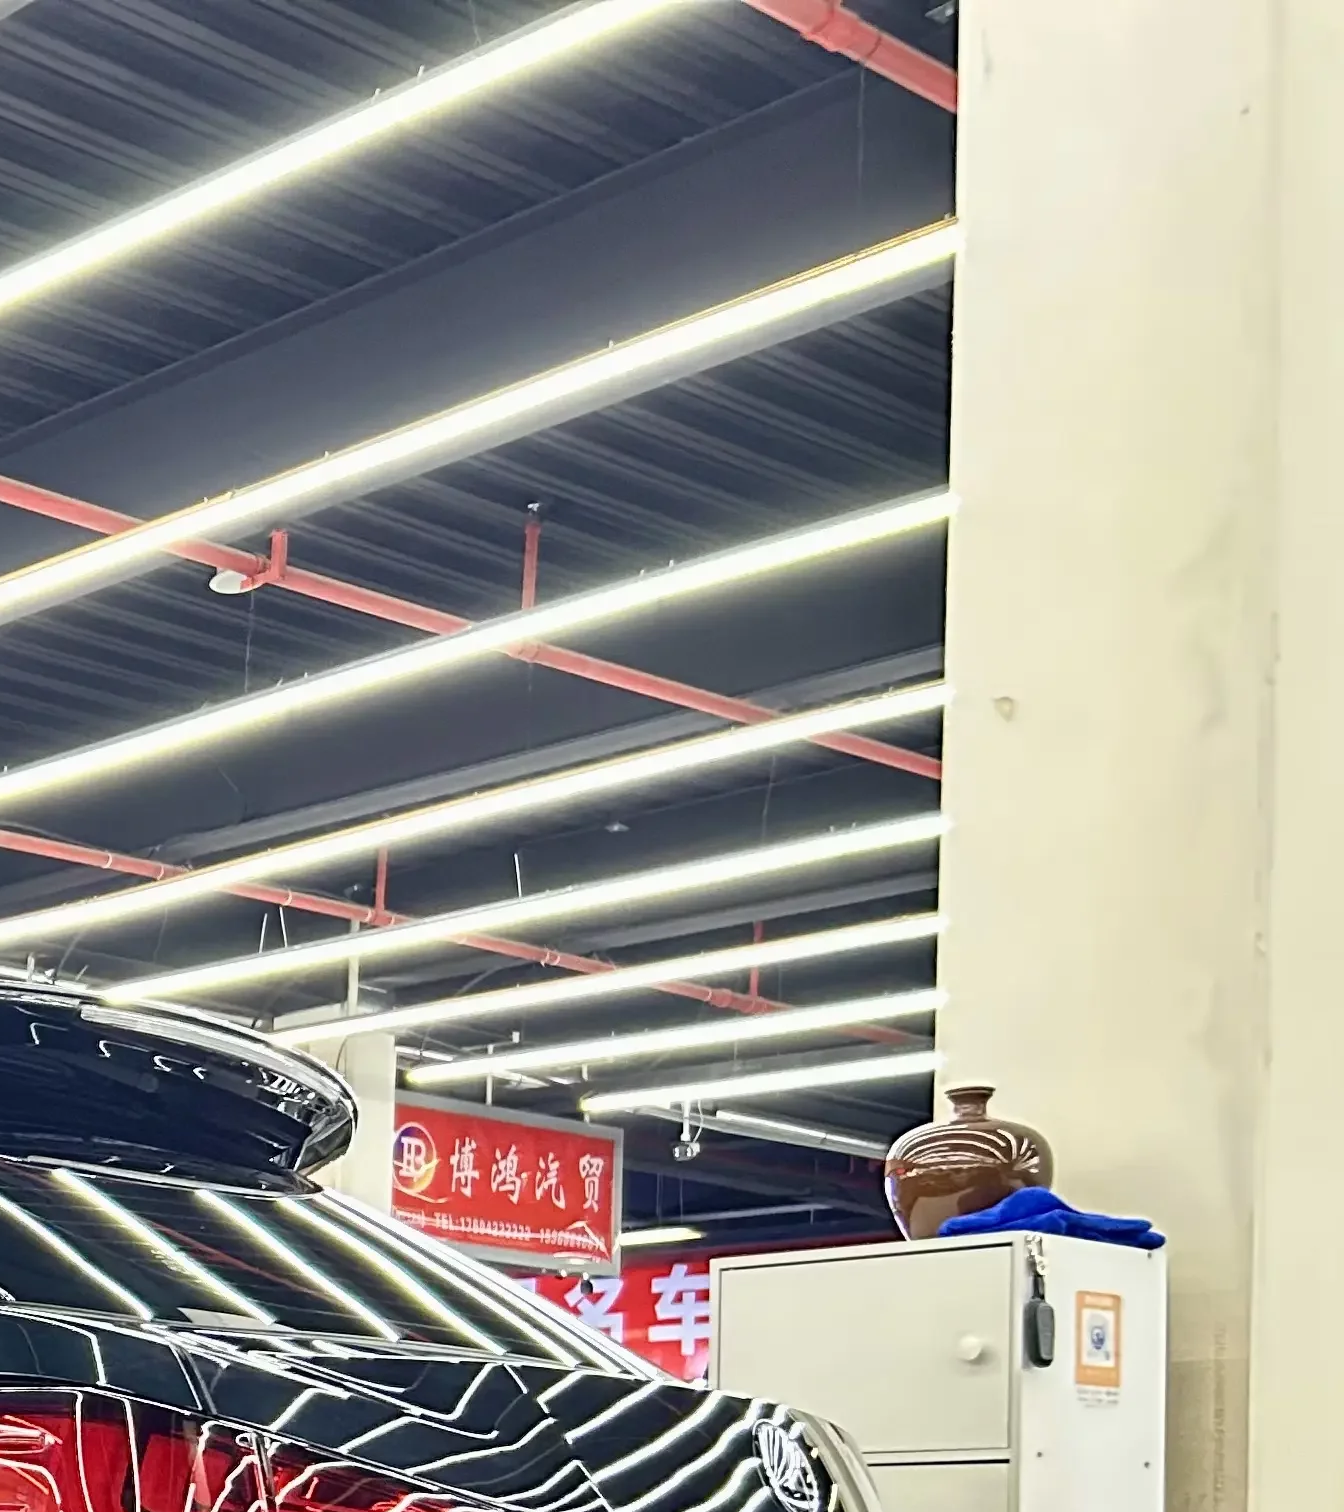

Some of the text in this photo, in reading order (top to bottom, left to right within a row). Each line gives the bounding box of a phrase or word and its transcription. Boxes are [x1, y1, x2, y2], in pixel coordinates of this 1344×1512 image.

[450, 1137, 604, 1212] 博鸿汽贸
[516, 1263, 711, 1356] 名车
